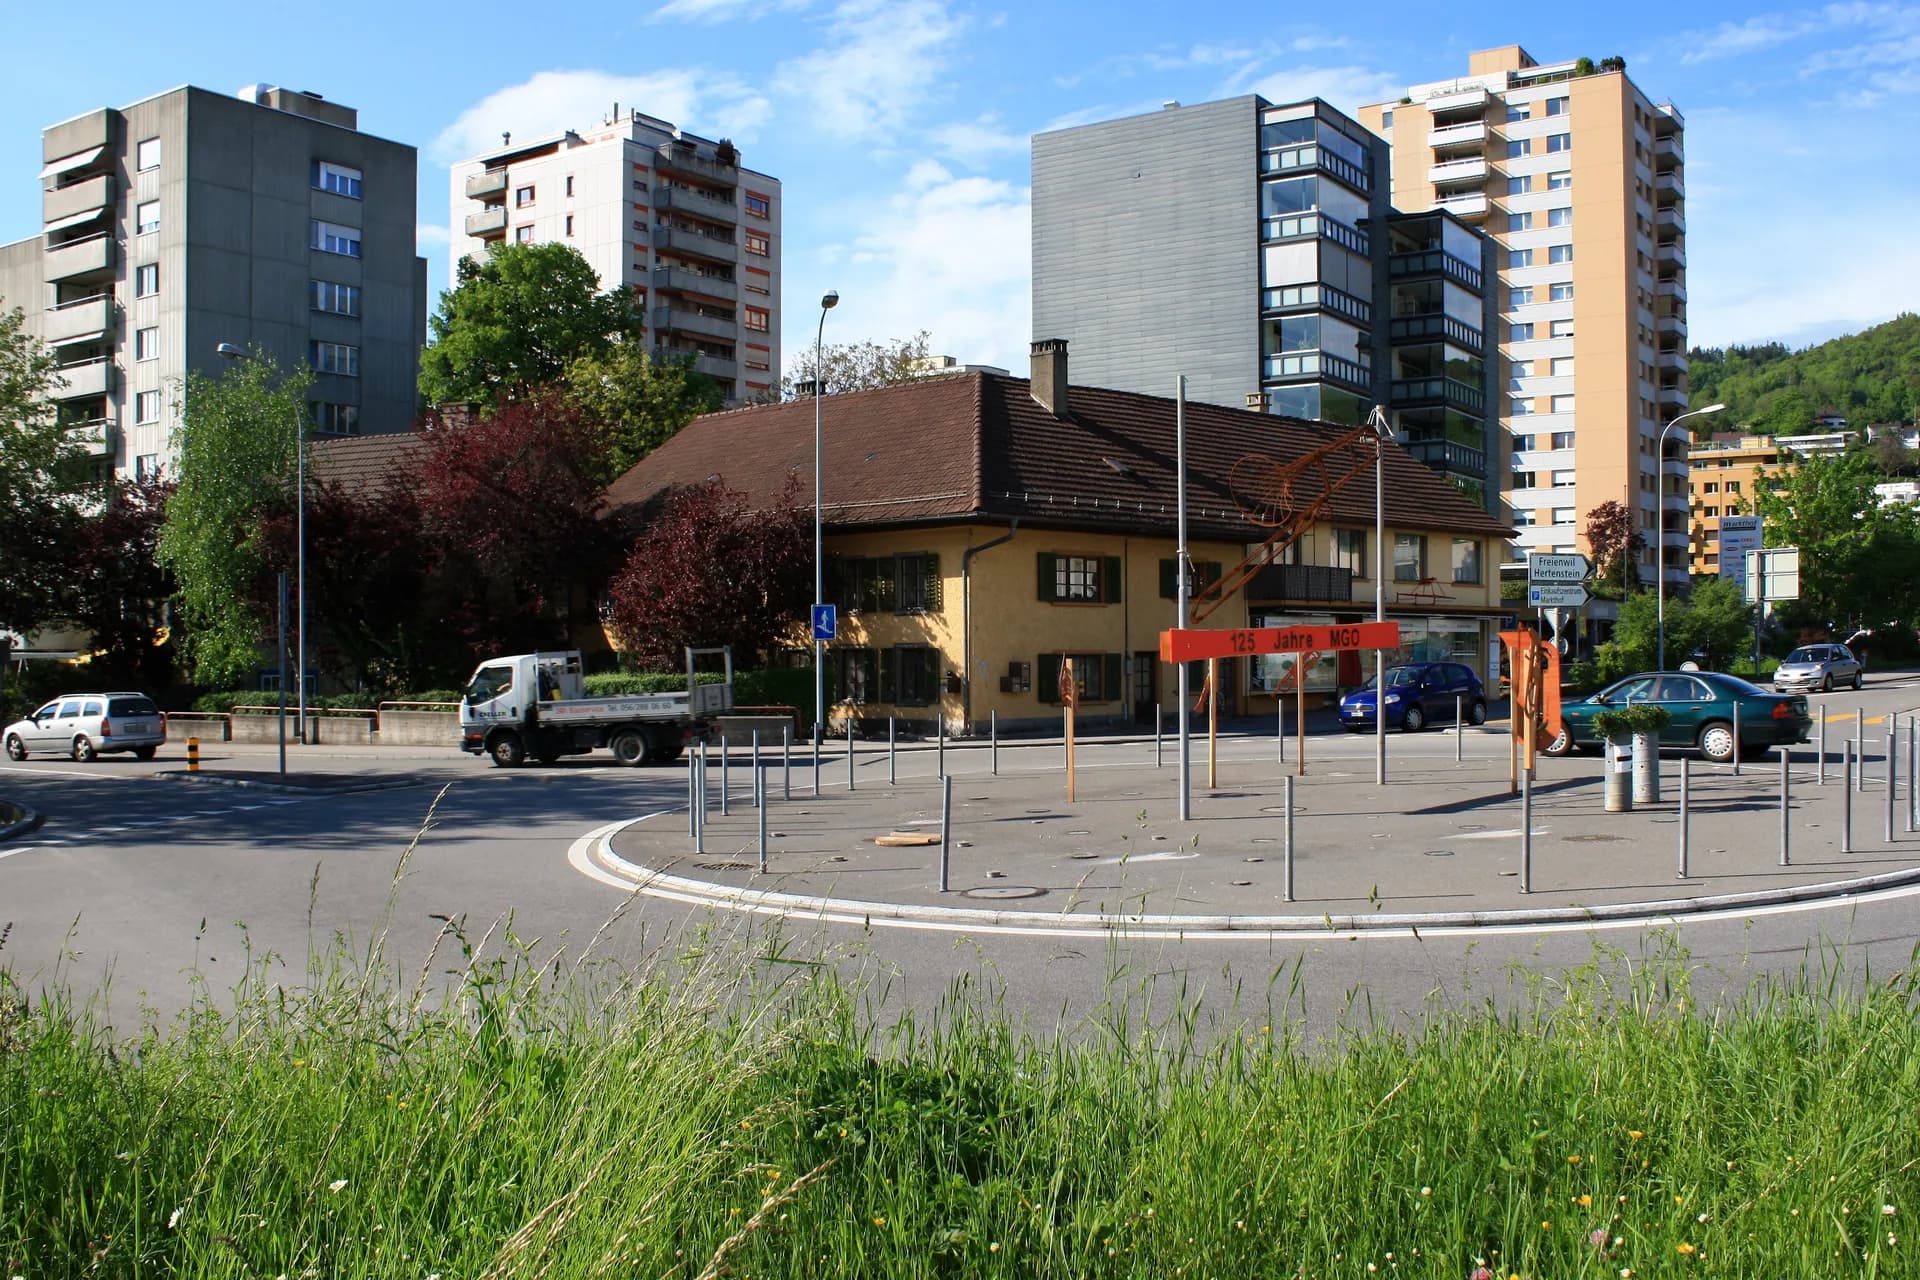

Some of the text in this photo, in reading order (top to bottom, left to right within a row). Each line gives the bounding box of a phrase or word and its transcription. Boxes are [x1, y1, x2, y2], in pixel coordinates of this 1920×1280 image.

[1539, 557, 1575, 566] Freienwil
[1534, 568, 1580, 578] Hertenstein
[1230, 628, 1360, 651] 125 Jahre MGO
